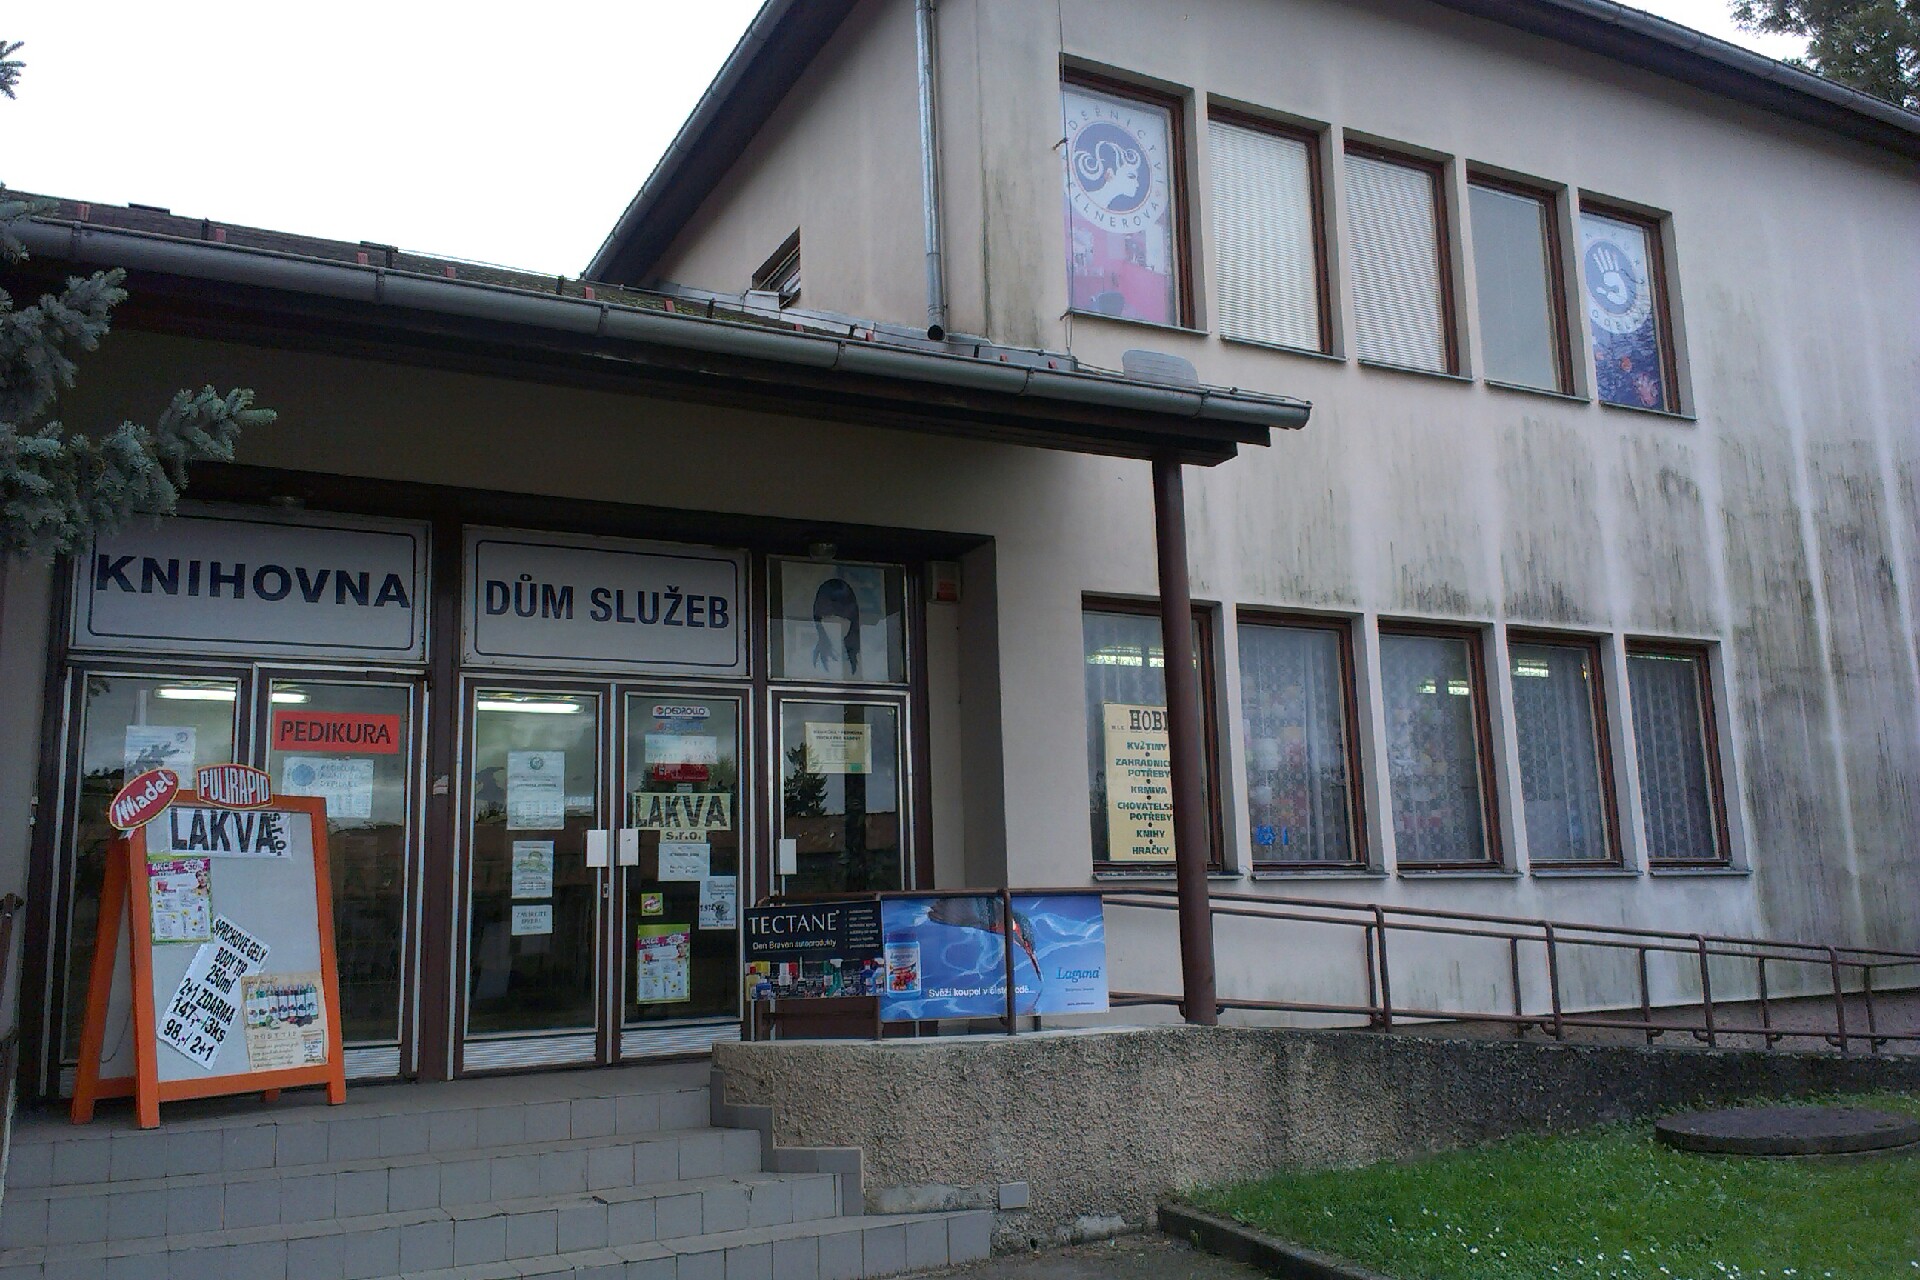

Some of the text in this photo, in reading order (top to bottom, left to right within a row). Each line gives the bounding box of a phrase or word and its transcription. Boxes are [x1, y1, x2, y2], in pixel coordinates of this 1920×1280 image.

[96, 553, 411, 608] KNIHOVNA
[486, 573, 729, 629] DŮM SLUŽEB
[279, 719, 392, 744] PEDIKURA
[1129, 709, 1169, 731] HOB
[1115, 758, 1171, 768] ZAHRADNIC
[1128, 768, 1171, 778] POTŘEBY
[200, 767, 270, 805] PULIRAPID
[1131, 785, 1168, 794] KRMIVA
[635, 794, 728, 828] LAKVA
[1129, 812, 1172, 821] POTŘEBY
[170, 807, 276, 854] LAKVA
[665, 831, 702, 841] s.r.o.
[1136, 829, 1165, 838] KNIHY
[1132, 844, 1169, 855] HRAČKY
[752, 942, 768, 951] Den
[214, 946, 239, 971] BODY
[204, 963, 237, 995] 250ml
[179, 977, 237, 1026] 2+1 ZDARMA
[953, 986, 981, 999] koupel
[982, 988, 989, 996] v
[1014, 985, 1036, 994] odě...
[189, 1035, 215, 1062] 2+1
